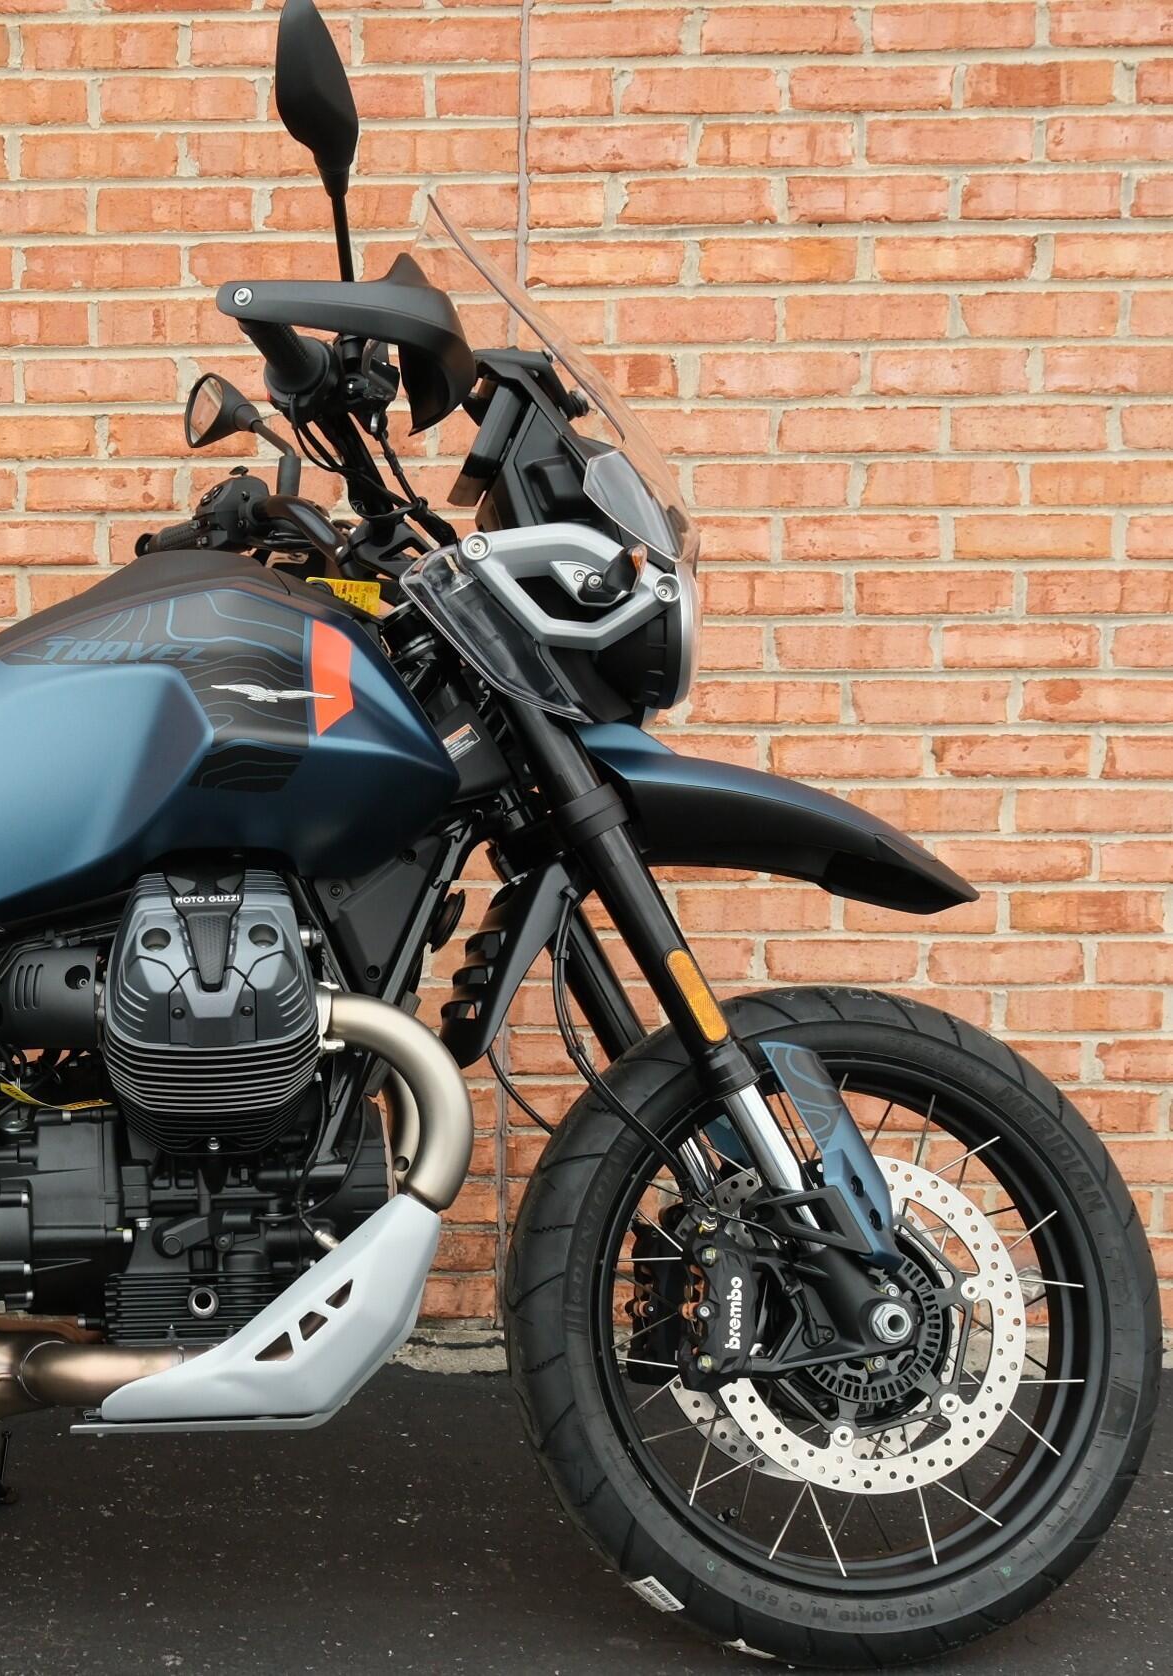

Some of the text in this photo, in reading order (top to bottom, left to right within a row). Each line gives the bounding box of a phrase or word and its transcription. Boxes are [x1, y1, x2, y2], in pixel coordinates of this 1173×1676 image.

[42, 640, 208, 663] TRAVEL
[175, 894, 240, 904] MOTO GUZZI
[995, 1086, 1106, 1213] MERIDIAN
[724, 1276, 743, 1349] brembo
